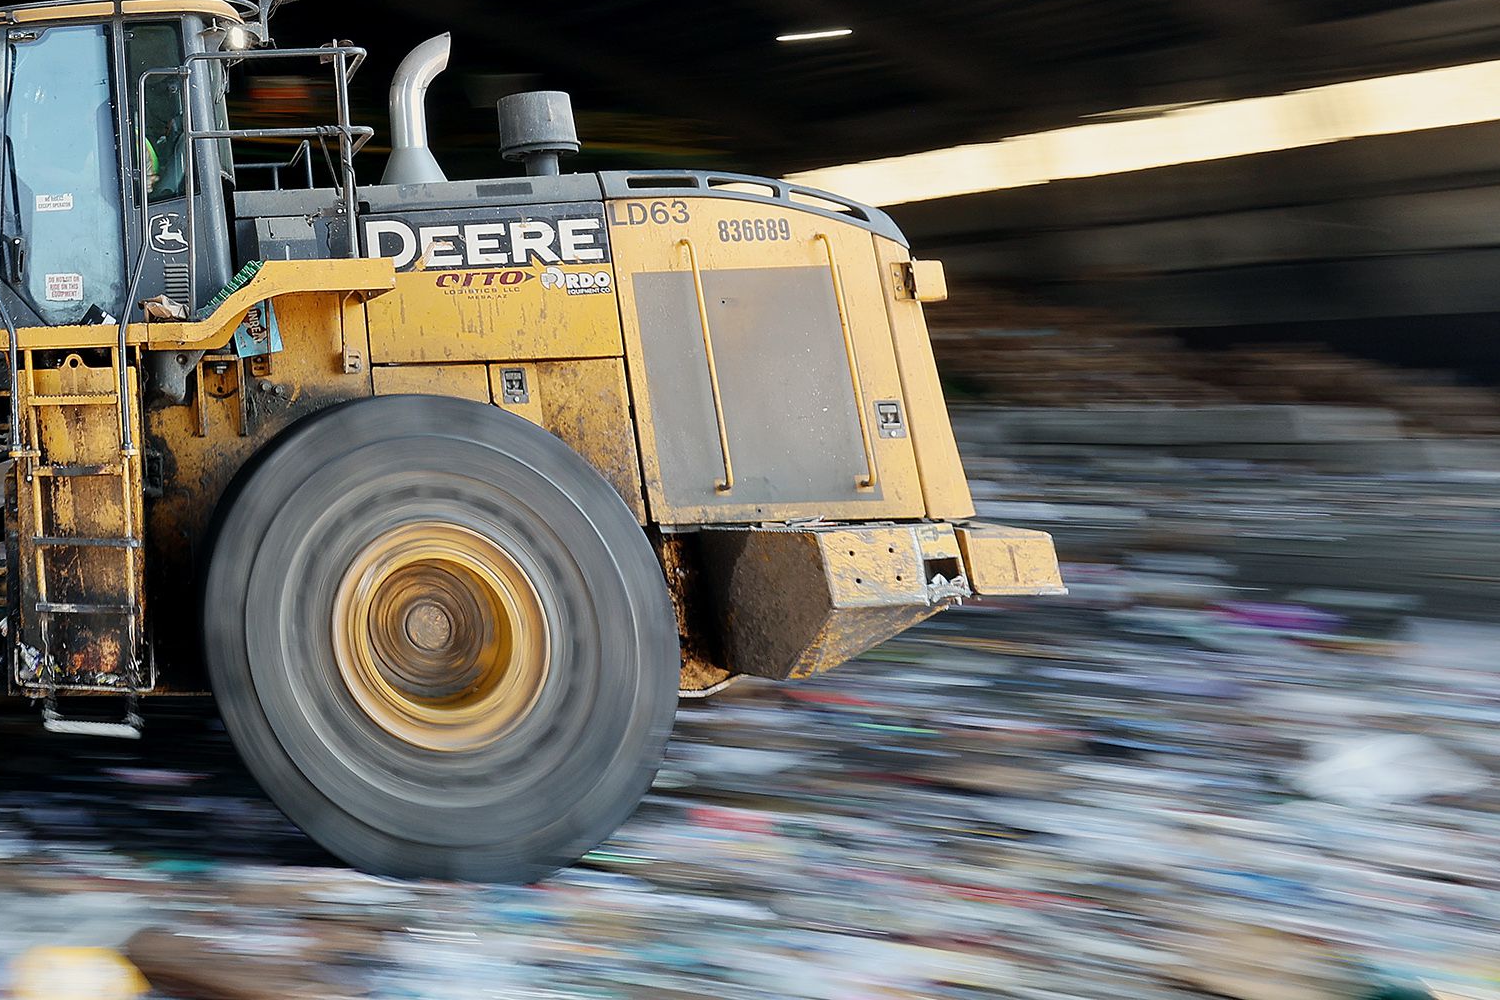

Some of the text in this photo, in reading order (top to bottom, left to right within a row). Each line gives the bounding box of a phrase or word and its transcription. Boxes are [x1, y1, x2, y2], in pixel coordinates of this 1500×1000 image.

[608, 200, 690, 226] LD63
[718, 218, 791, 242] 836689
[365, 218, 604, 268] DEERE
[444, 287, 498, 295] LOGISTICS
[566, 271, 611, 289] RDO
